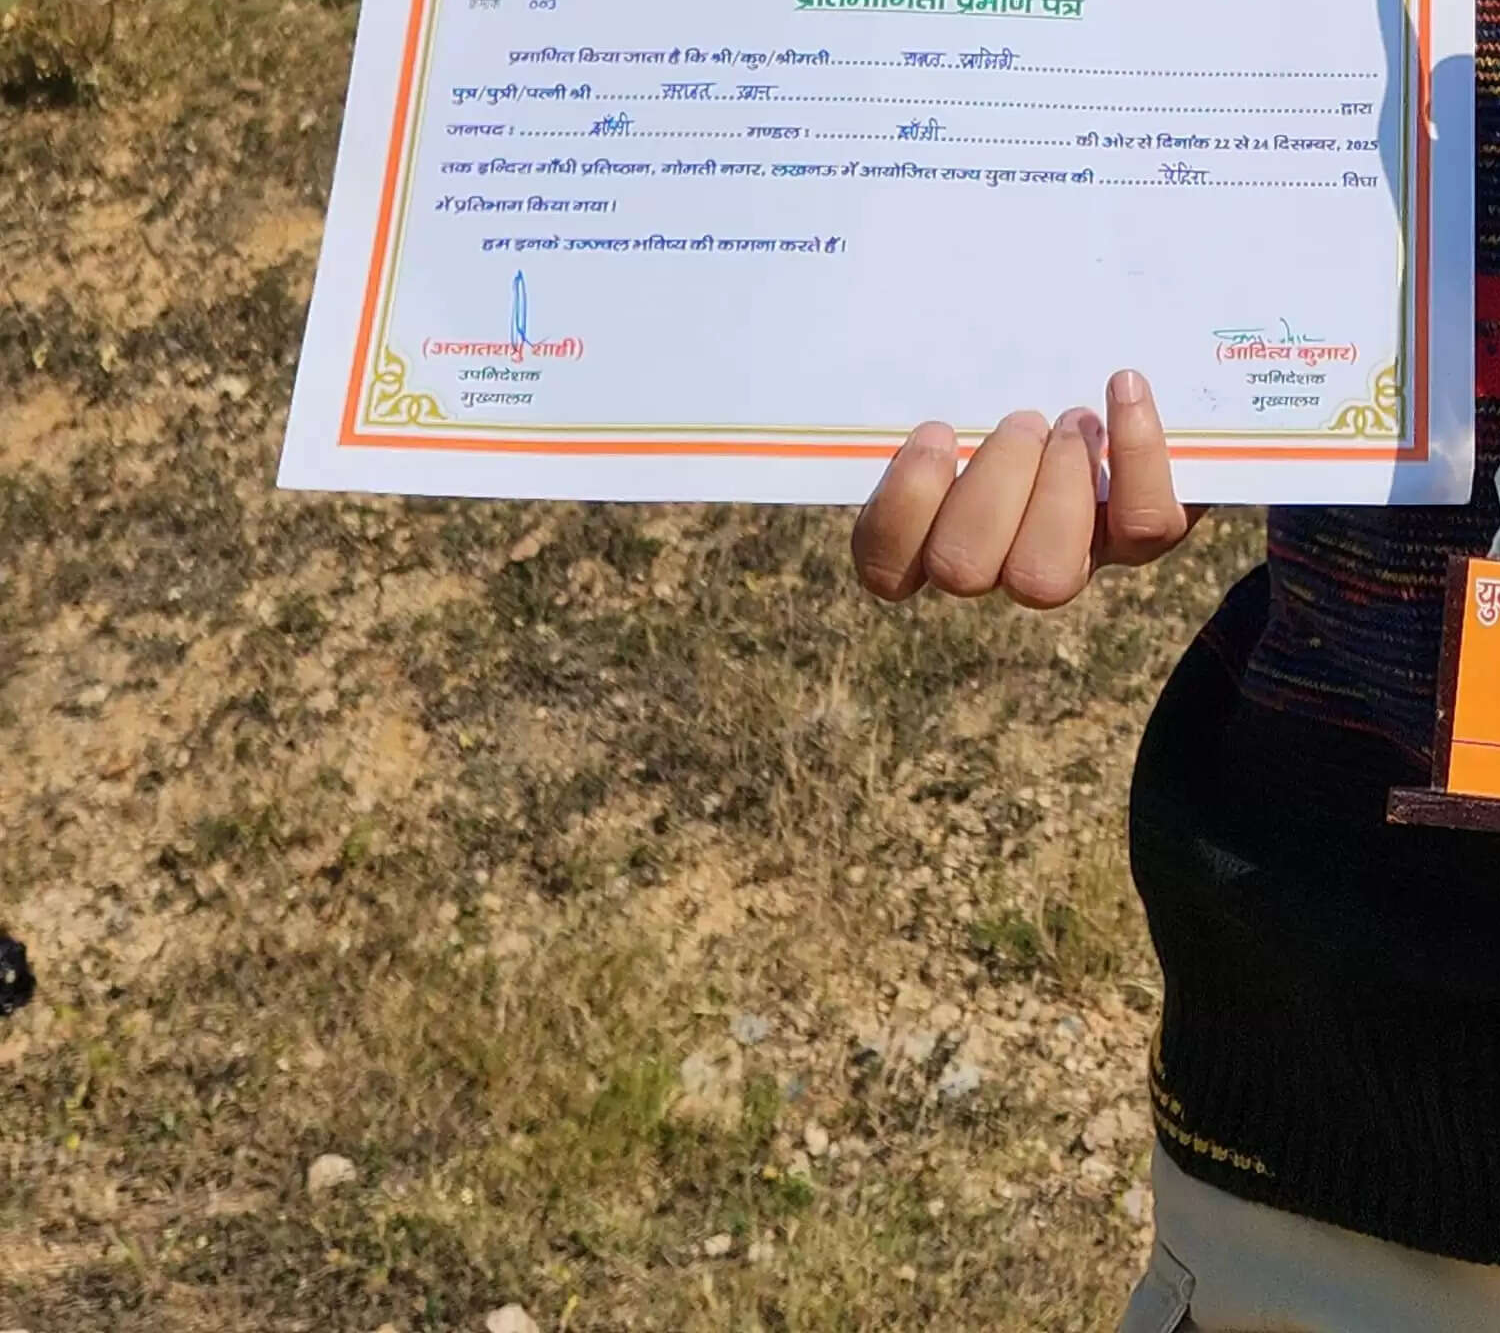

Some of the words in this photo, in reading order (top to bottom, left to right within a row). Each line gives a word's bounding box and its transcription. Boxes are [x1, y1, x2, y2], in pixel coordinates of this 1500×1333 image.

[509, 47, 574, 65] प्रमाणित
[578, 47, 620, 63] किया
[624, 51, 665, 64] जाता
[668, 47, 681, 64] है
[684, 47, 708, 63] कि
[570, 84, 592, 100] श्री
[1340, 102, 1373, 116] द्वारा
[1076, 132, 1098, 149] की
[1102, 132, 1133, 149] ओर
[1134, 133, 1152, 149] से
[1156, 133, 1211, 150] दिनांक
[1214, 138, 1230, 150] 22
[1234, 134, 1249, 150] से
[1346, 138, 1379, 151] 2025
[441, 162, 472, 174] तक
[770, 162, 837, 177] लखनऊ
[841, 161, 860, 178] में
[860, 161, 937, 180] आयोजित
[941, 167, 980, 181] राज्य
[985, 169, 1016, 187] युवा
[1019, 170, 1067, 184] उत्सव
[1071, 168, 1094, 184] की
[455, 196, 523, 215] प्रतिभाग
[526, 196, 570, 213] किया
[482, 237, 510, 251] हम
[515, 235, 560, 251] इनके
[632, 235, 687, 251] भविष्य
[690, 235, 714, 252] की
[717, 238, 776, 252] कामना
[779, 237, 821, 253] करते
[1297, 342, 1357, 366] कुमार)
[458, 366, 541, 382] उपनिदेशक
[1246, 370, 1326, 385] उपनिदेशक
[461, 391, 534, 408] मुख्यालय
[1252, 395, 1320, 411] मुख्यालय
